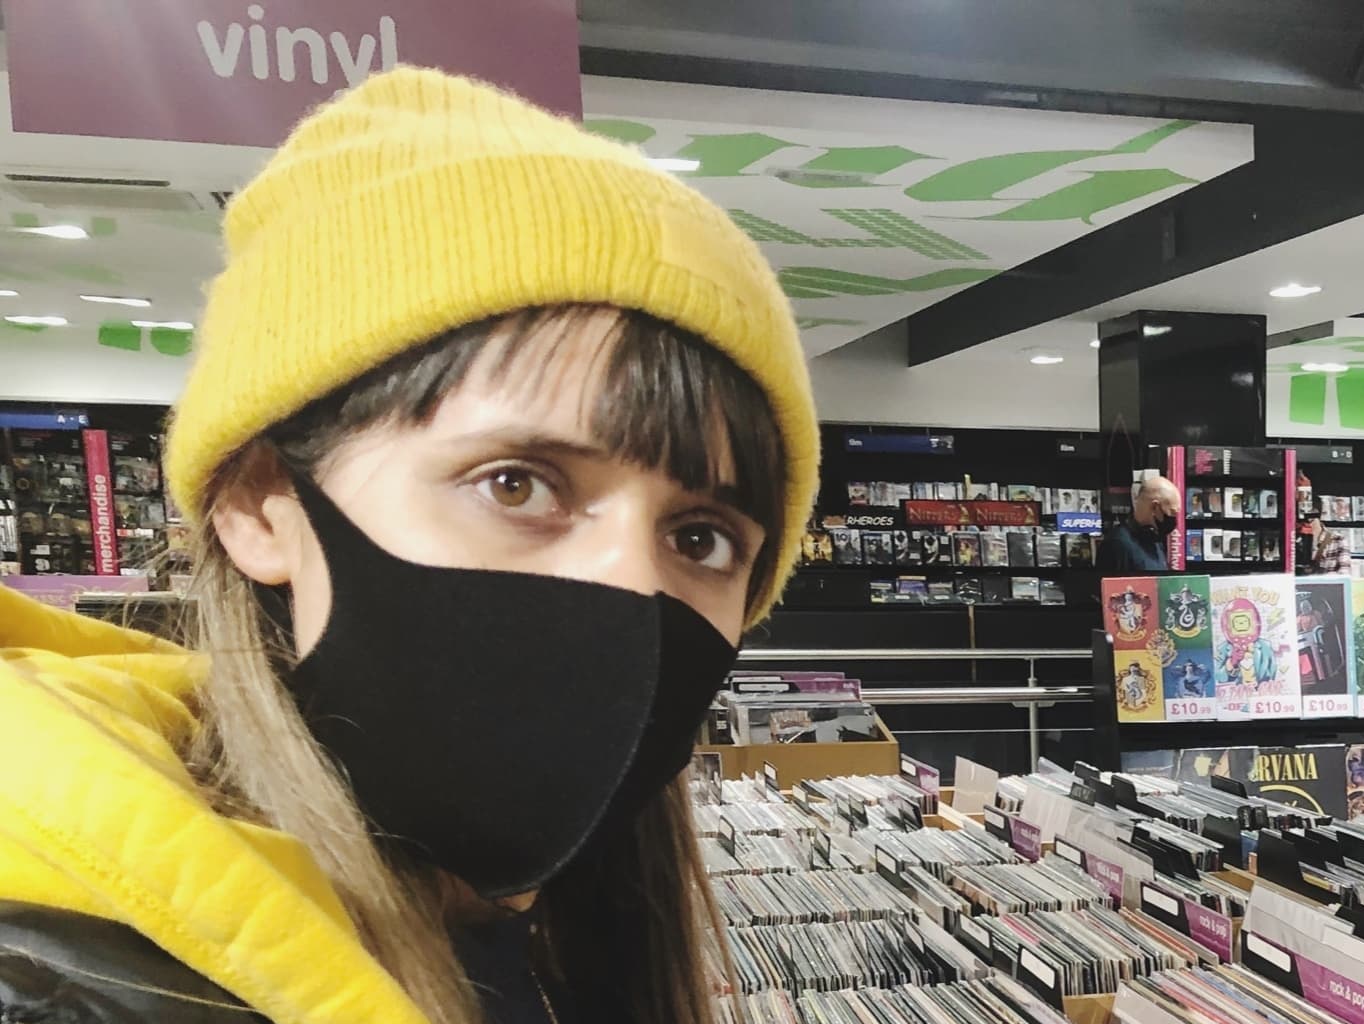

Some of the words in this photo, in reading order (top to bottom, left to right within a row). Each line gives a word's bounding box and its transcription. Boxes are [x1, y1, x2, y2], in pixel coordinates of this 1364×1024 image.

[197, 4, 398, 97] vinyl
[94, 474, 114, 573] merchandise
[1329, 980, 1345, 997] rock
[1344, 985, 1352, 1001] &
